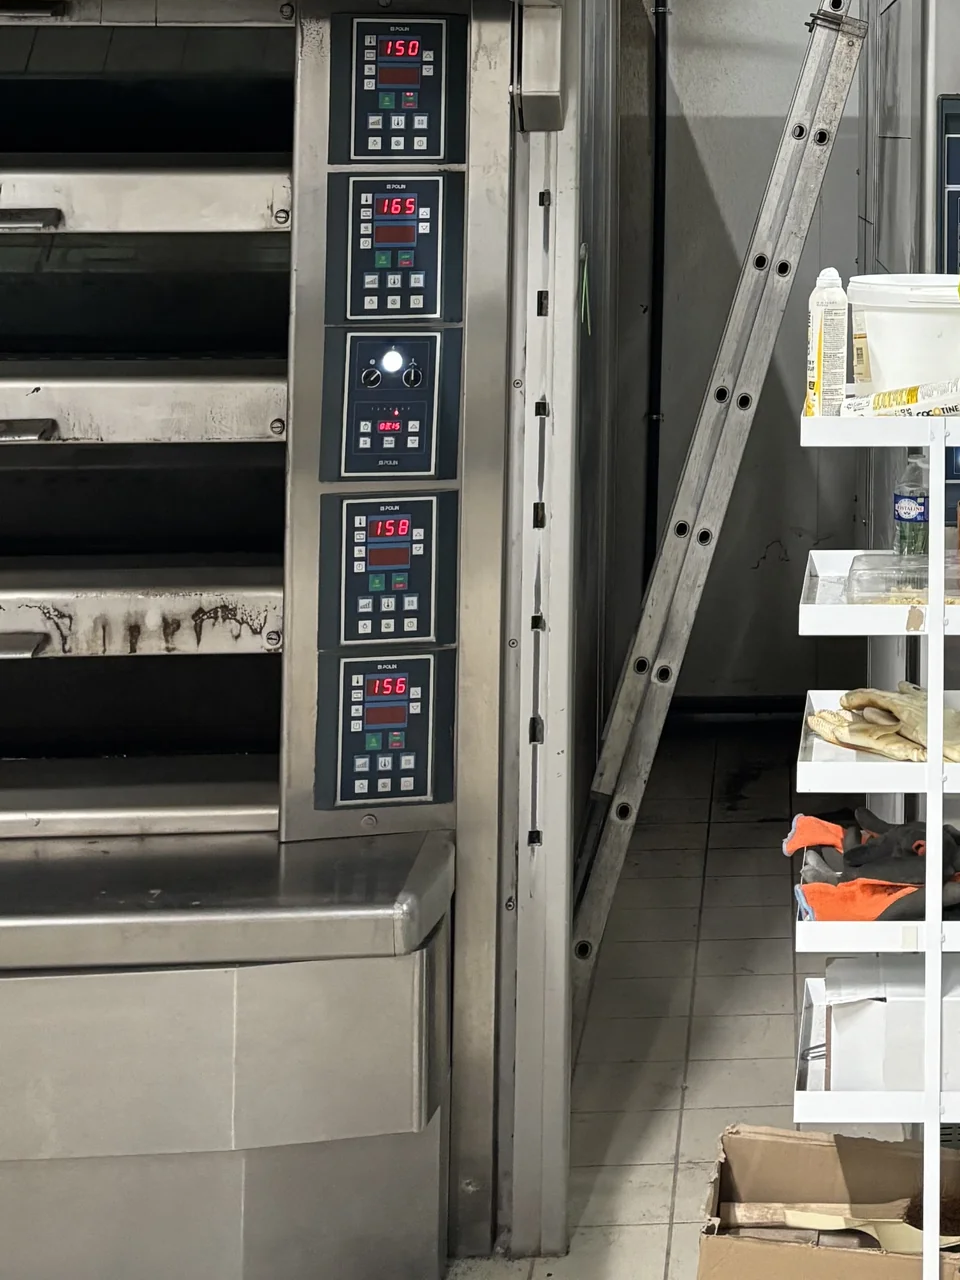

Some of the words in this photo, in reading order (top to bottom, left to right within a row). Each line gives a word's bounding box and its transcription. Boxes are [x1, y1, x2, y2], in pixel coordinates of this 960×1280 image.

[387, 40, 419, 56] 150
[383, 198, 415, 214] 165
[377, 519, 409, 536] 158
[373, 677, 406, 694] 156
